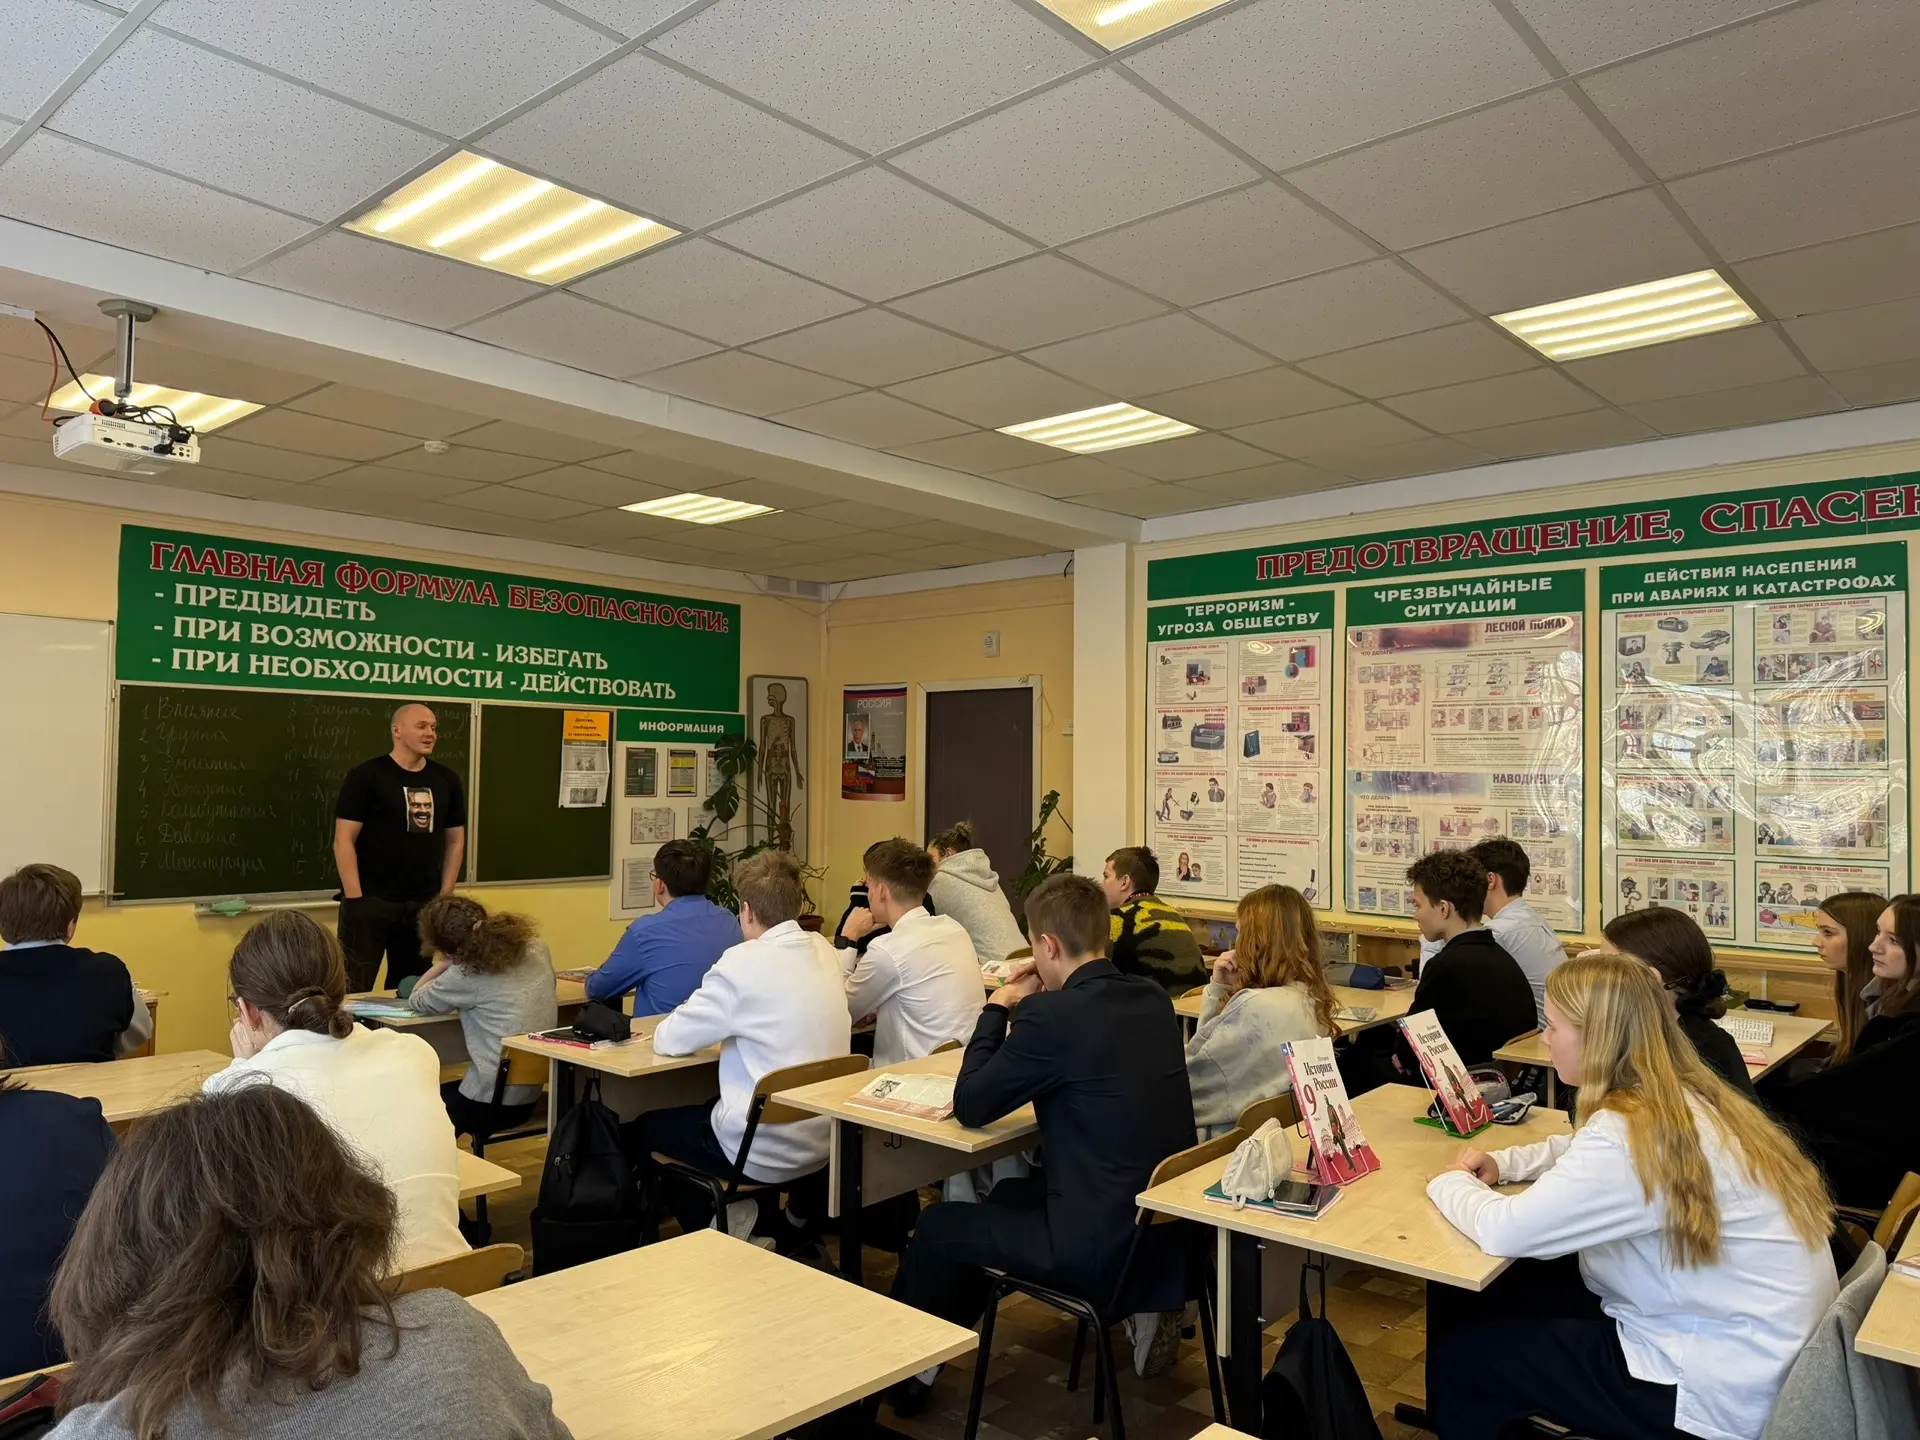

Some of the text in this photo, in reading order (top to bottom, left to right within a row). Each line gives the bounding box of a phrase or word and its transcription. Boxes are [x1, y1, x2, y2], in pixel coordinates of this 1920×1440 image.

[1256, 509, 1685, 580] ПРЕДОТВРАЩЕНИЕ,
[1644, 557, 1856, 584] ДЕЙСТВИЯ НАСЕЛЕНИЯ
[150, 541, 729, 633] ГЛАВНАЯ ФОРМУЛА БЕЗОПАСНОСТИ:
[1374, 577, 1552, 603] ЧРЕЗВЫЧАЙНЫЕ
[1612, 574, 1896, 604] ПРИ АВАРИЯХ И КАТАСТРОФАХ
[174, 583, 376, 621] ПРЕДВИДЕТЬ
[1185, 599, 1284, 617] ТЕРРОРИЗМ
[1404, 598, 1516, 618] СИТУАЦИИ
[1157, 612, 1320, 636] УГРОЗА ОБЩЕСТВУ
[1485, 619, 1526, 633] ЛЕСНОЙ
[173, 616, 241, 642] ПРИ
[250, 623, 475, 660] ВОЗМОЖНОСТИ
[496, 644, 608, 670] ИЗБЕГАТЬ
[171, 648, 240, 674] ПРИ
[248, 654, 503, 690] НЕОБХОДИМОСТИ
[520, 671, 676, 700] ДЕЙСТВОВАТЬ
[857, 698, 891, 709] РОССИЯ
[639, 721, 724, 734] ИНФОРМАЦИЯ
[1493, 773, 1565, 786] НАВОДНЕНЕ
[1416, 1030, 1443, 1045] История
[1427, 1042, 1450, 1056] России
[1303, 1062, 1334, 1077] История
[1422, 1052, 1437, 1077] 9
[1313, 1078, 1338, 1091] России
[1303, 1084, 1317, 1116] 9
